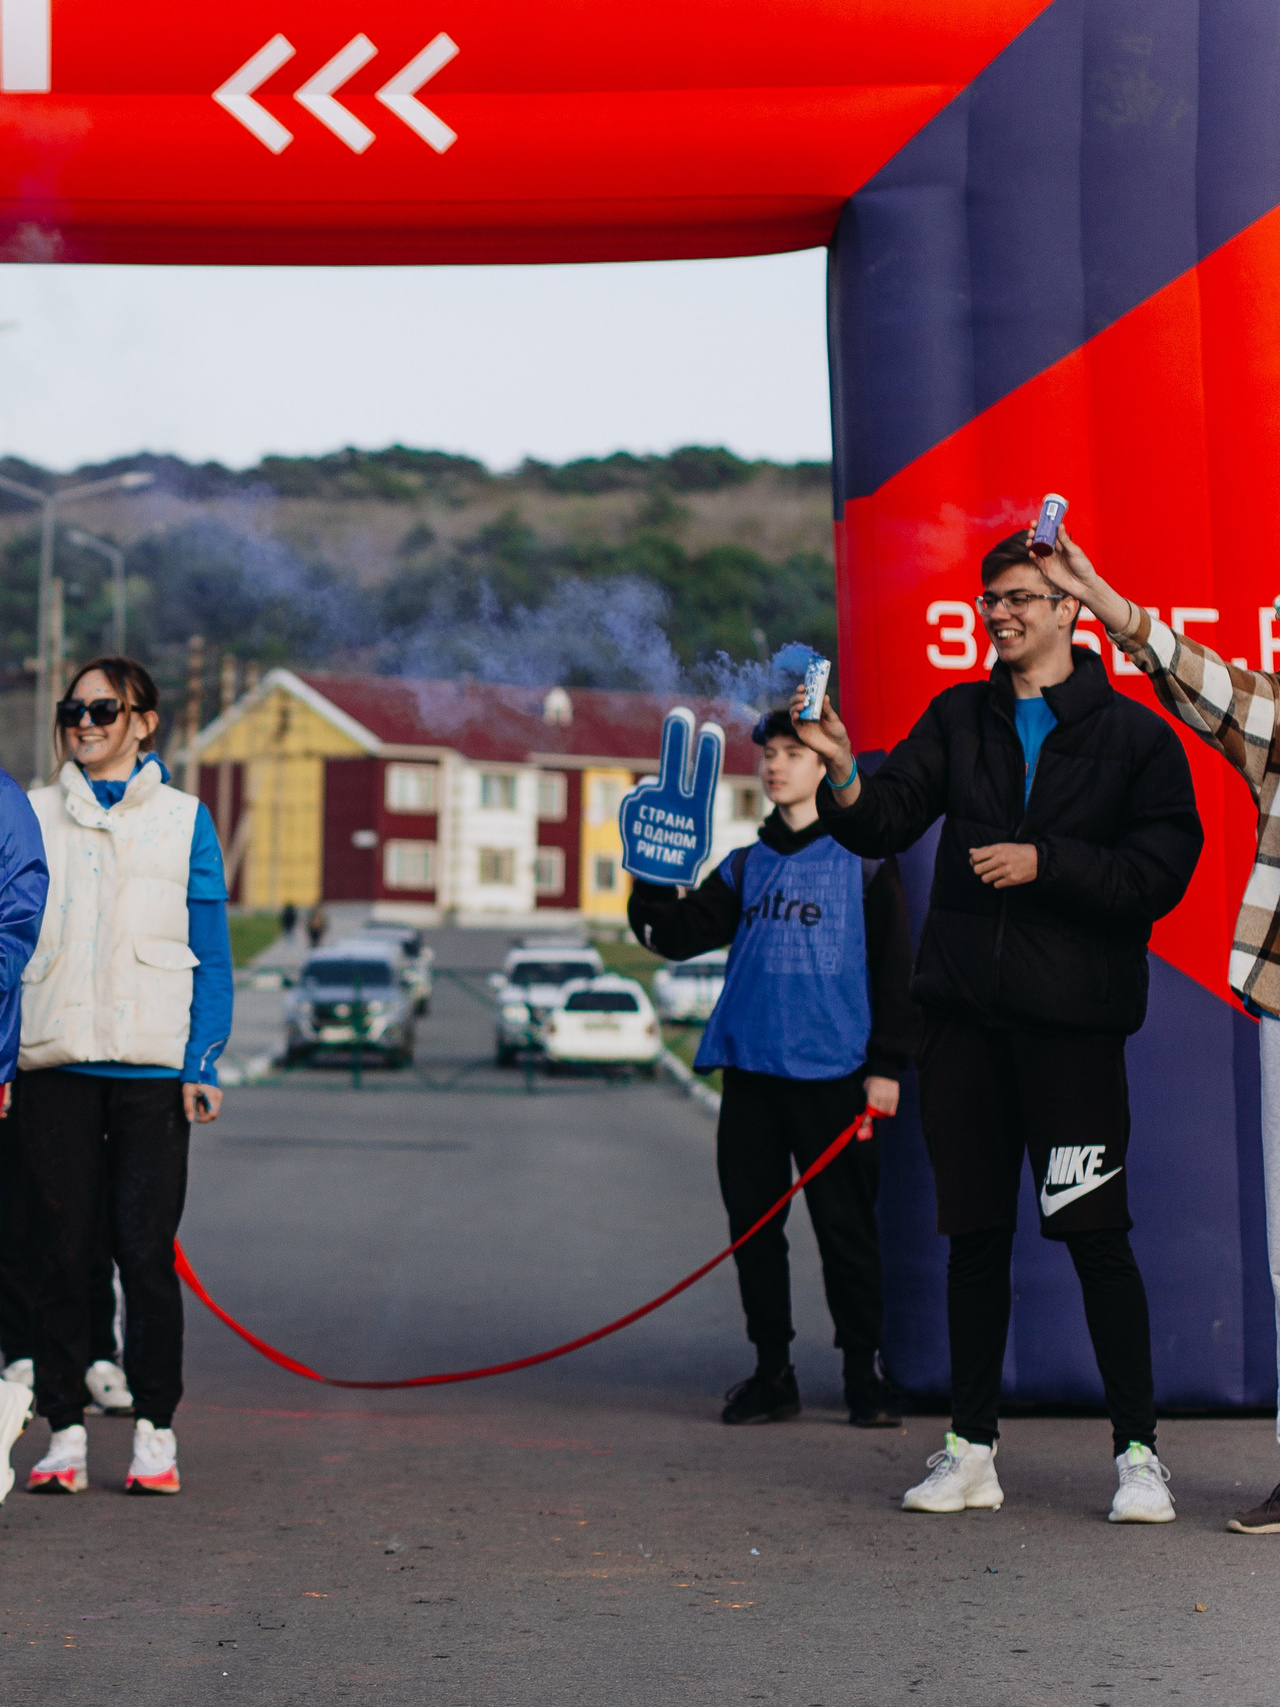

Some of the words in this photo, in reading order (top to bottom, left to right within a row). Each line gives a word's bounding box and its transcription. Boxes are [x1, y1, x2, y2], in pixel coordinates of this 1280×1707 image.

[639, 804, 695, 832] СТРАНА
[632, 820, 642, 836] В
[644, 824, 697, 849] ОДНОМ
[637, 839, 686, 866] РИТМЕ
[1046, 1145, 1106, 1185] NIKE
